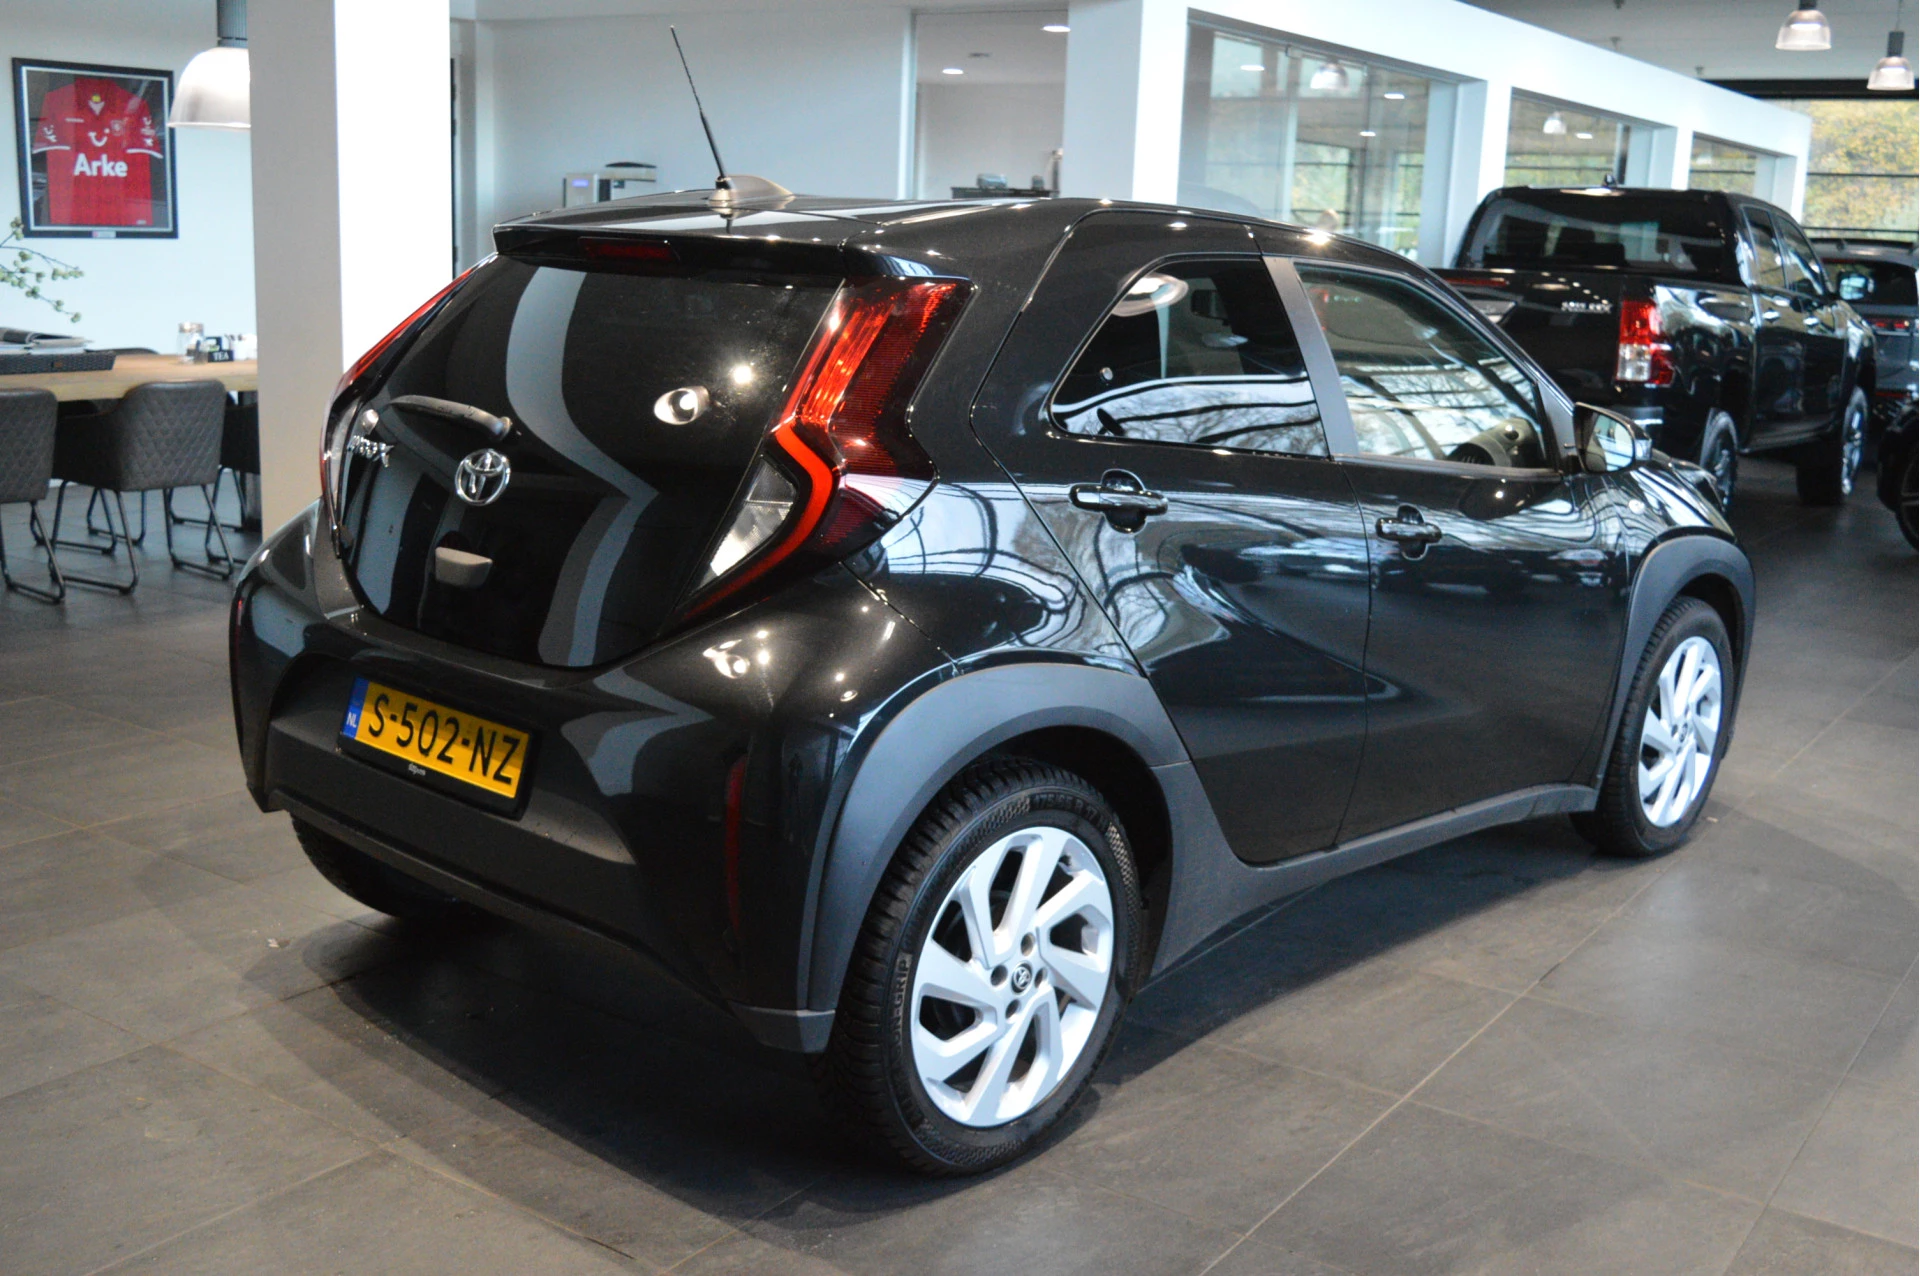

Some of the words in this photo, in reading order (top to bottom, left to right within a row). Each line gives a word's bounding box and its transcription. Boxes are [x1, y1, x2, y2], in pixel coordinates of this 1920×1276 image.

[74, 152, 128, 177] Arke
[212, 351, 230, 362] TEA
[346, 712, 357, 728] NL
[368, 693, 520, 785] S-502-NZ
